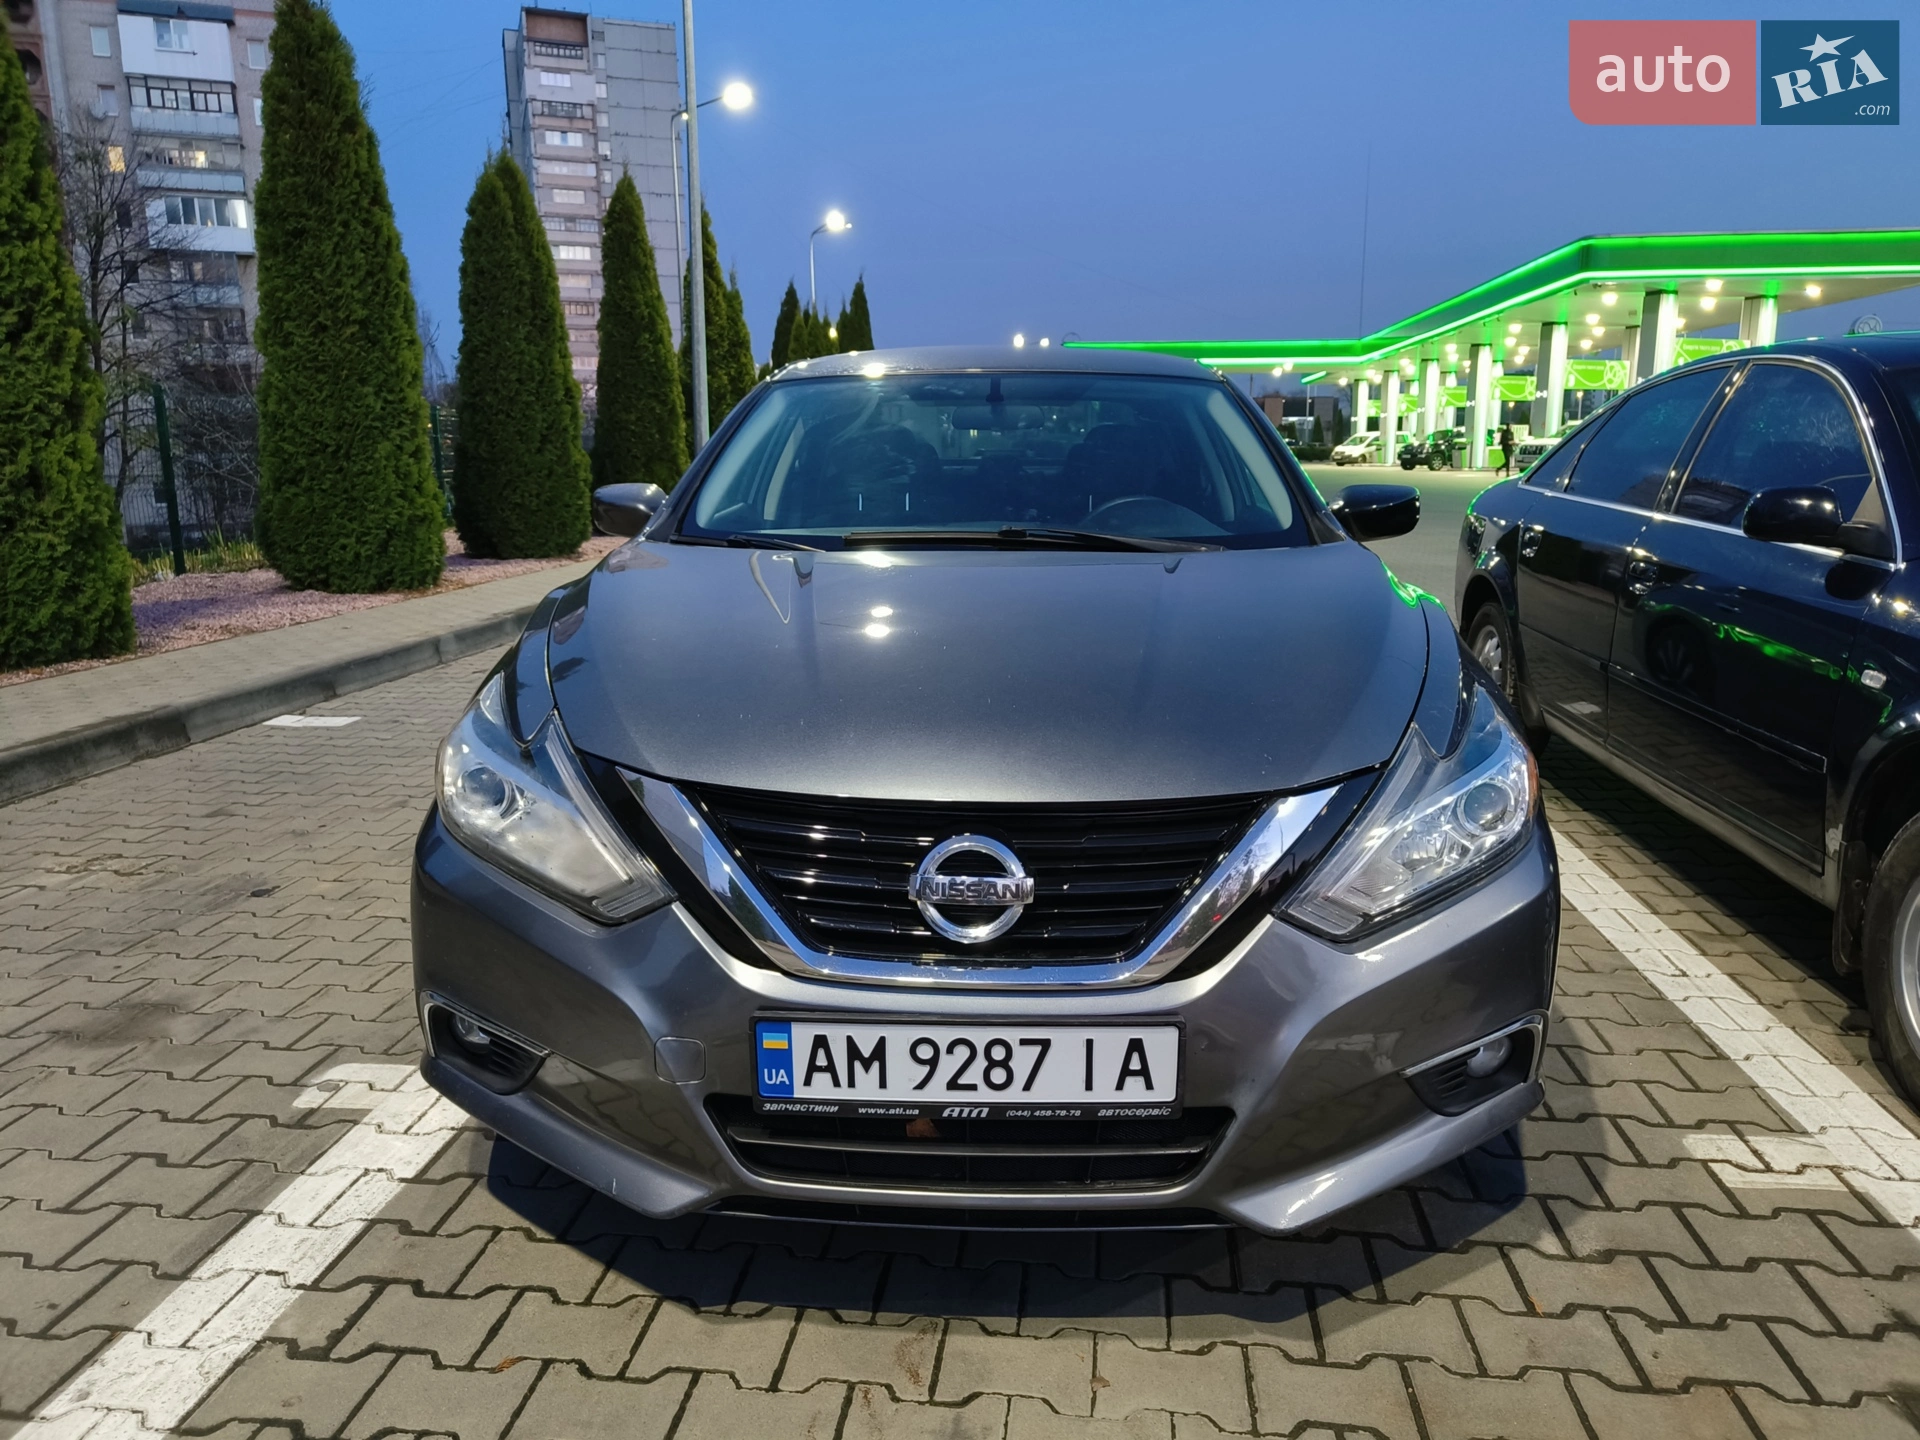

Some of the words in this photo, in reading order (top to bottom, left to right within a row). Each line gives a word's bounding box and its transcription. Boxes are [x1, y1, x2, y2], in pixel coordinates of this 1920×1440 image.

[920, 879, 1021, 900] NISSAN
[802, 1033, 887, 1090] AM
[908, 1036, 1052, 1092] 9287
[763, 1068, 790, 1085] UA
[762, 1102, 839, 1113] запчастини
[857, 1106, 920, 1115] www.atl.ua
[1005, 1109, 1032, 1118] (044)
[1097, 1105, 1172, 1117] автосервіс
